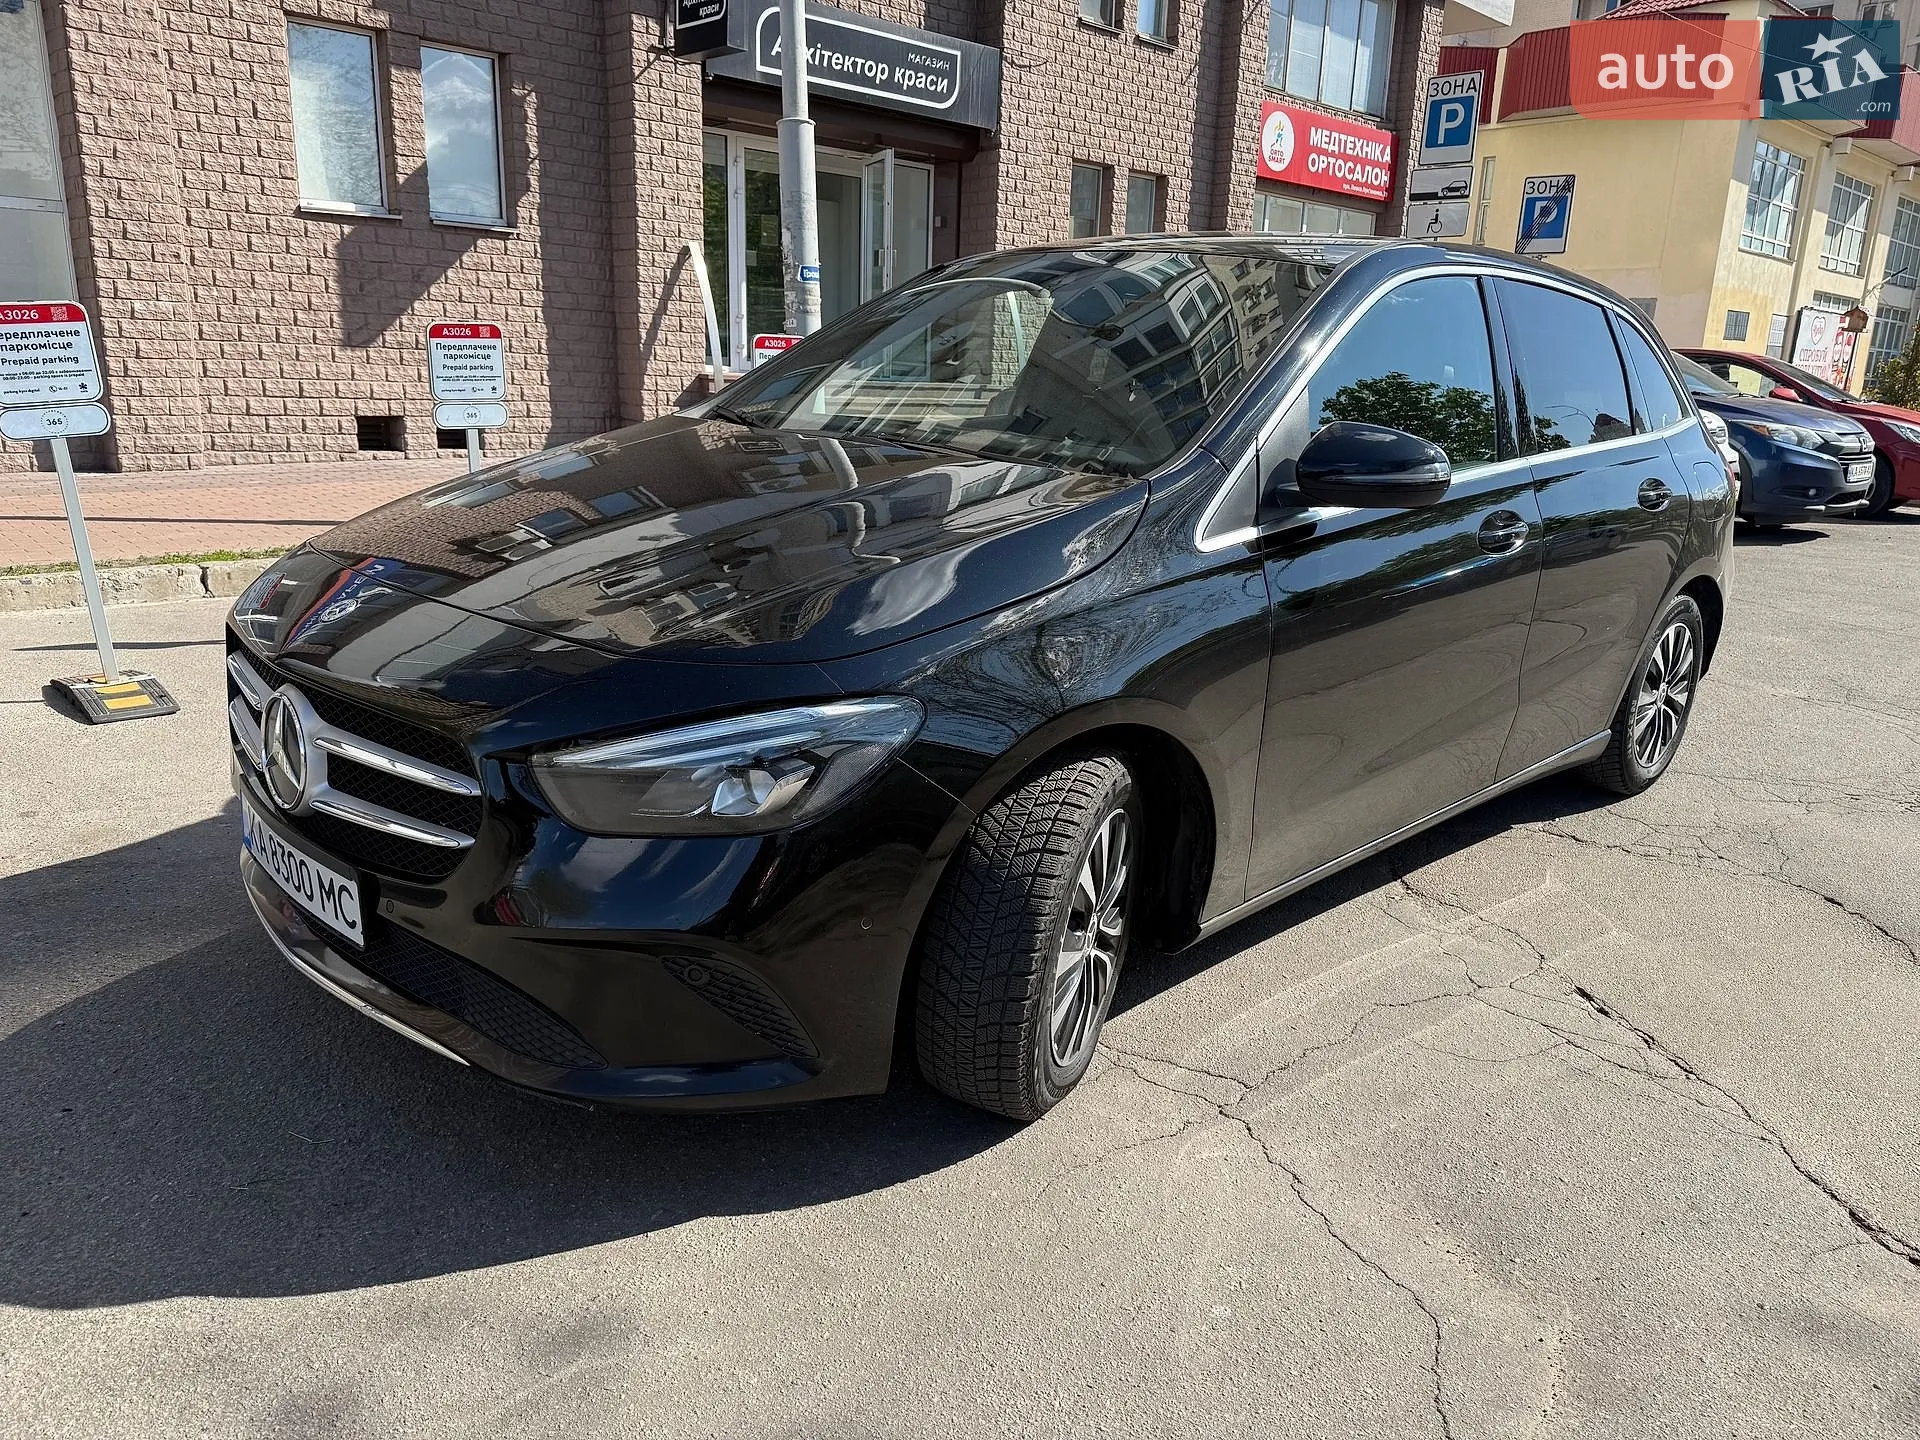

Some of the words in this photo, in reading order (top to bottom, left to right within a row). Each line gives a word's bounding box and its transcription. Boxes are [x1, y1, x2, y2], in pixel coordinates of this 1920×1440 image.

[770, 35, 888, 81] Ахітектор
[894, 66, 949, 94] краси
[907, 51, 950, 71] МАГАЗИН
[1429, 76, 1478, 98] ЗОНА
[1437, 102, 1465, 145] P
[1309, 126, 1392, 163] МЕДТЕХНІКА
[1308, 153, 1391, 188] ОРТОСАЛОН
[0, 329, 81, 341] ередплачене
[442, 327, 472, 336] A3026
[0, 340, 74, 354] паркомісце
[435, 343, 497, 352] Передплачене
[764, 340, 787, 348] A3026
[1, 357, 39, 367] Prepaid
[42, 355, 79, 366] parking
[443, 352, 491, 361] паркомісце
[442, 363, 468, 372] Prepaid
[469, 363, 494, 372] parking
[46, 418, 63, 426] 365
[269, 833, 315, 903] 8300
[316, 868, 357, 930] MC
